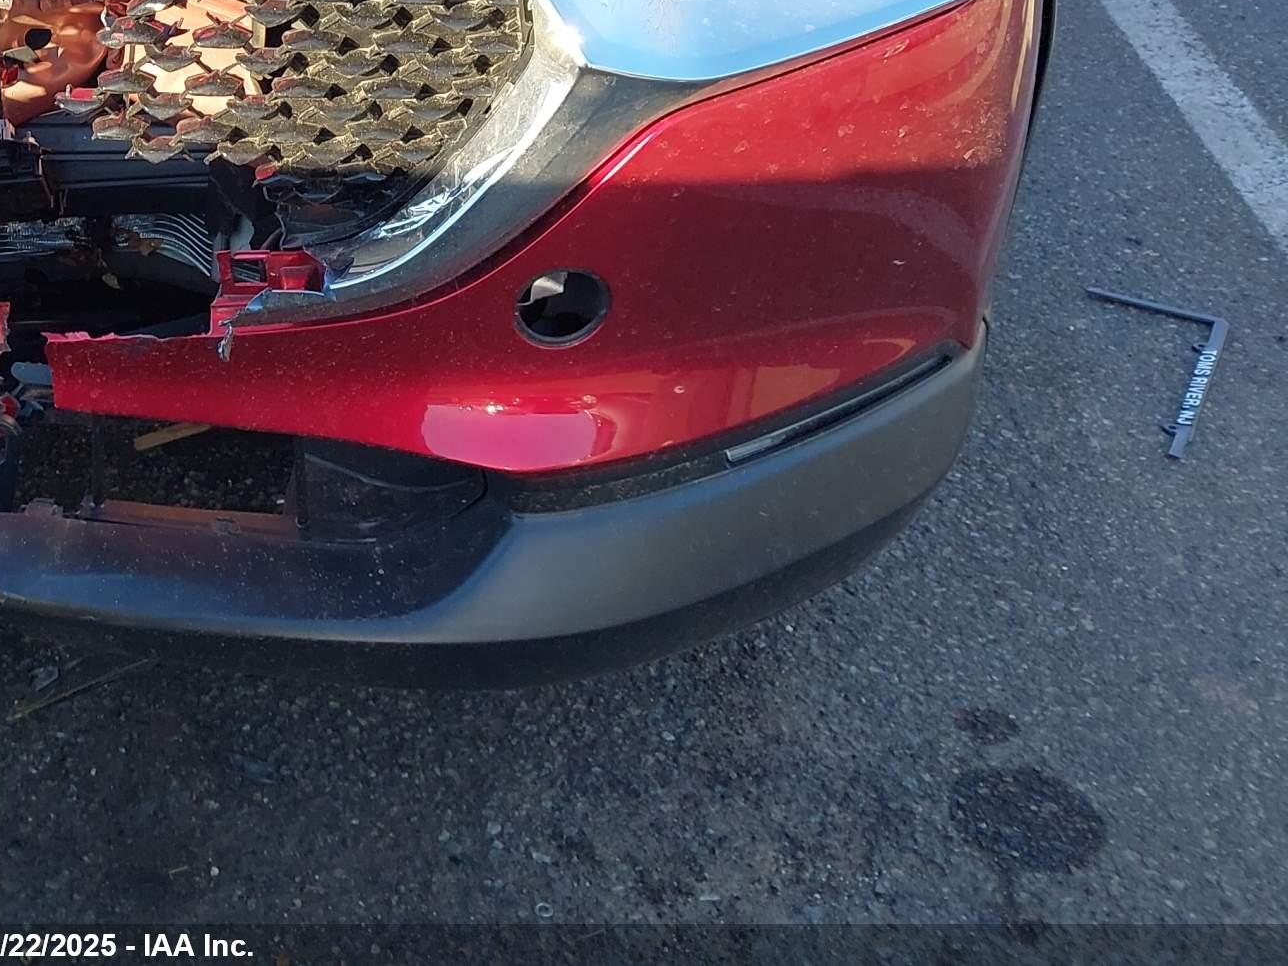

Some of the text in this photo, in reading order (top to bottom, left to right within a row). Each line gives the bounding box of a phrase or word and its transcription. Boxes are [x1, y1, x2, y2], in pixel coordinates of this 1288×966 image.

[1177, 350, 1218, 426] TOMS RIVER, NJ
